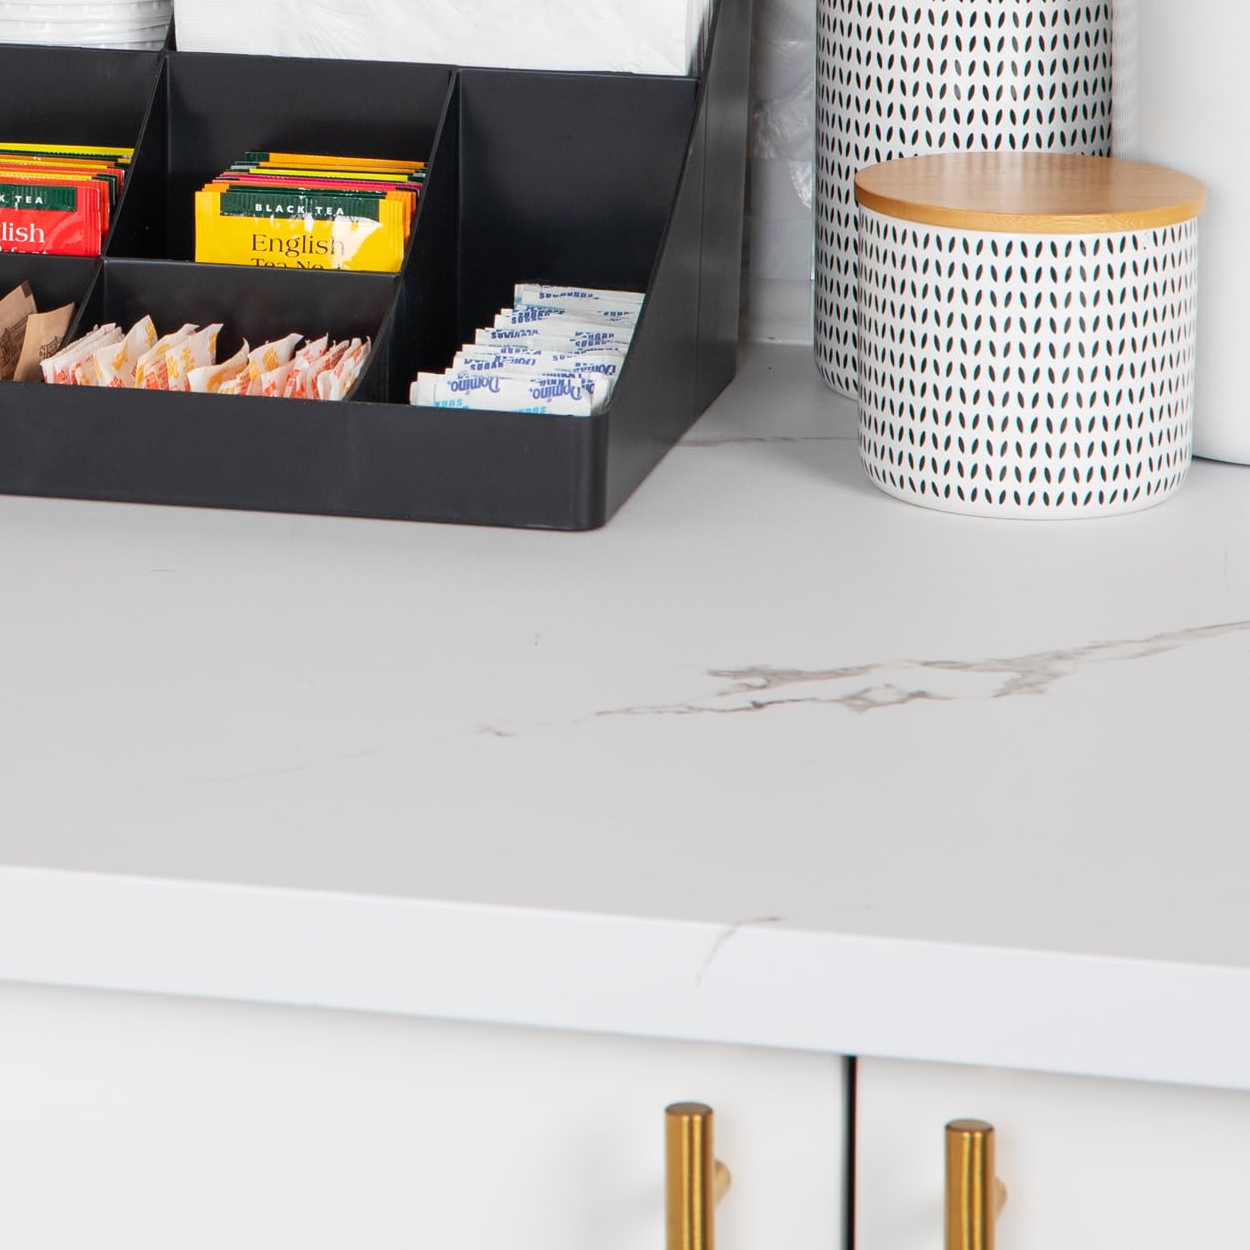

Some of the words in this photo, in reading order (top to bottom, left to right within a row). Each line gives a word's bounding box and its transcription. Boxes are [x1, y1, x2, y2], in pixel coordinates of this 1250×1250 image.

[15, 194, 44, 205] TEA
[255, 203, 305, 214] BLACK
[315, 206, 344, 215] TEA
[252, 233, 344, 258] English
